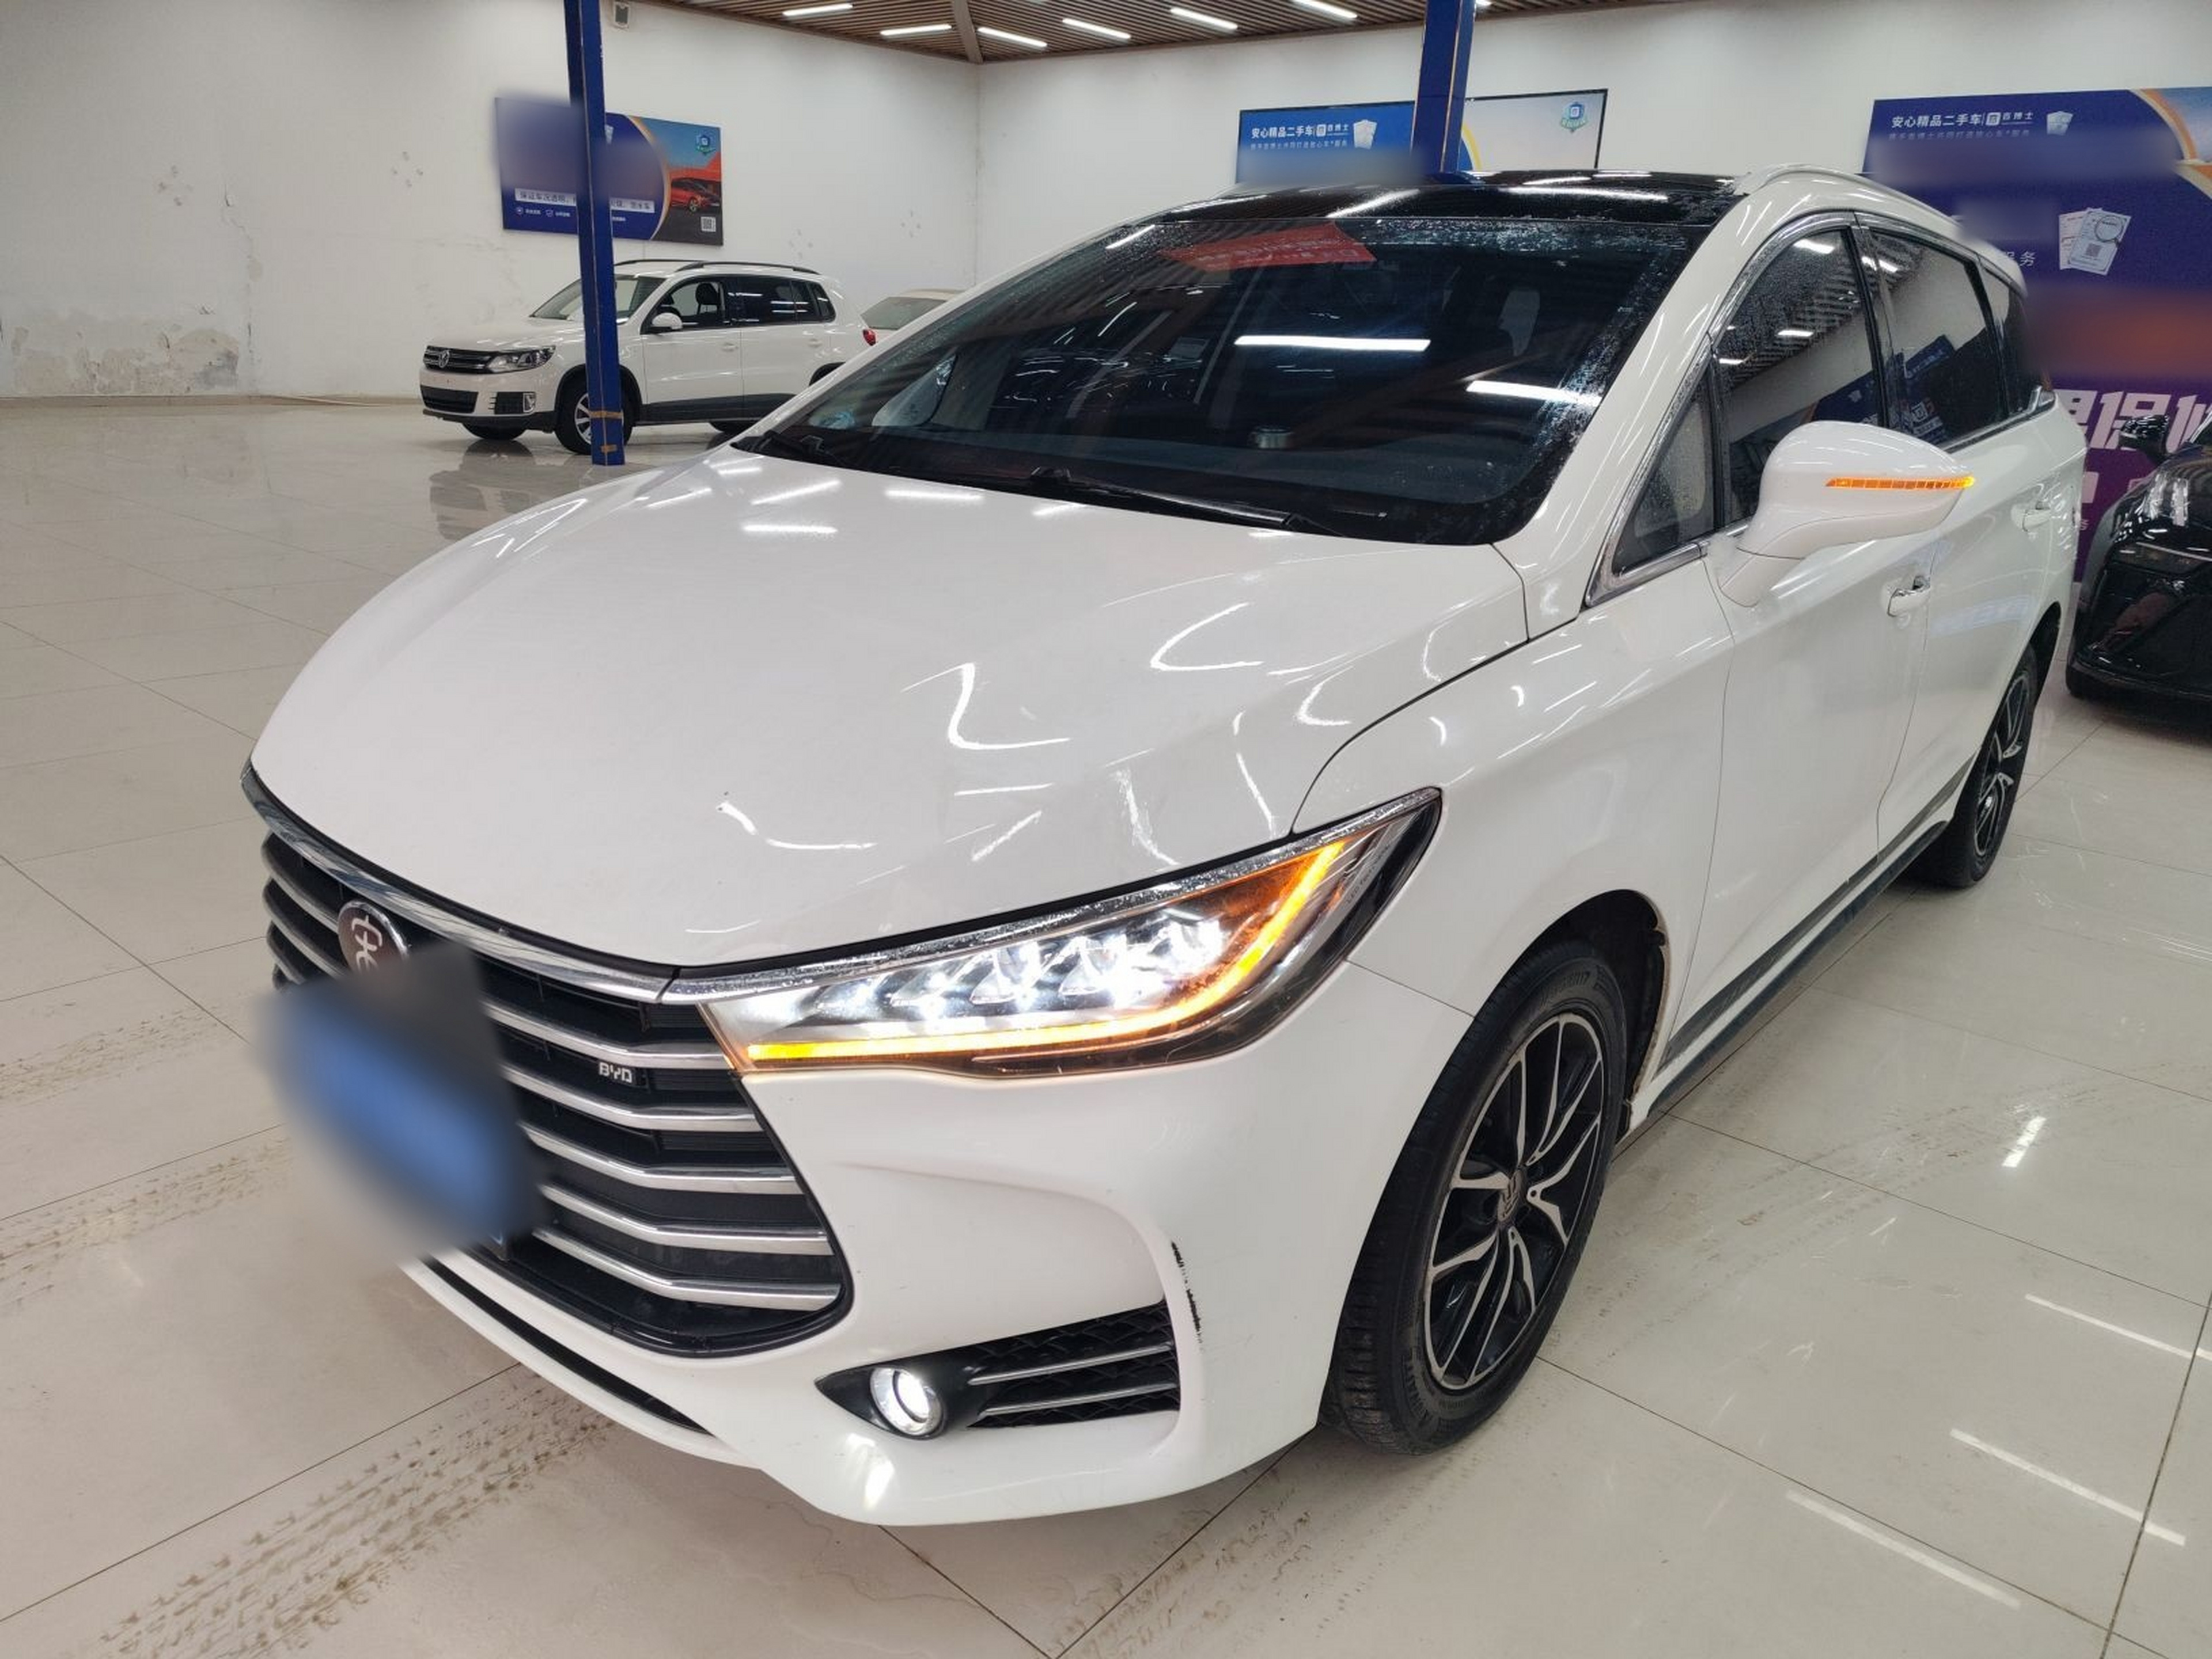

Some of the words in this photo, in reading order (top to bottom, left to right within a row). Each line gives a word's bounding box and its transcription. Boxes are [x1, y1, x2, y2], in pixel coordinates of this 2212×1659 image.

[1892, 114, 1982, 128] 安心精品二手车
[1251, 125, 1313, 139] 安心精品二手车
[599, 1061, 632, 1084] BYD
